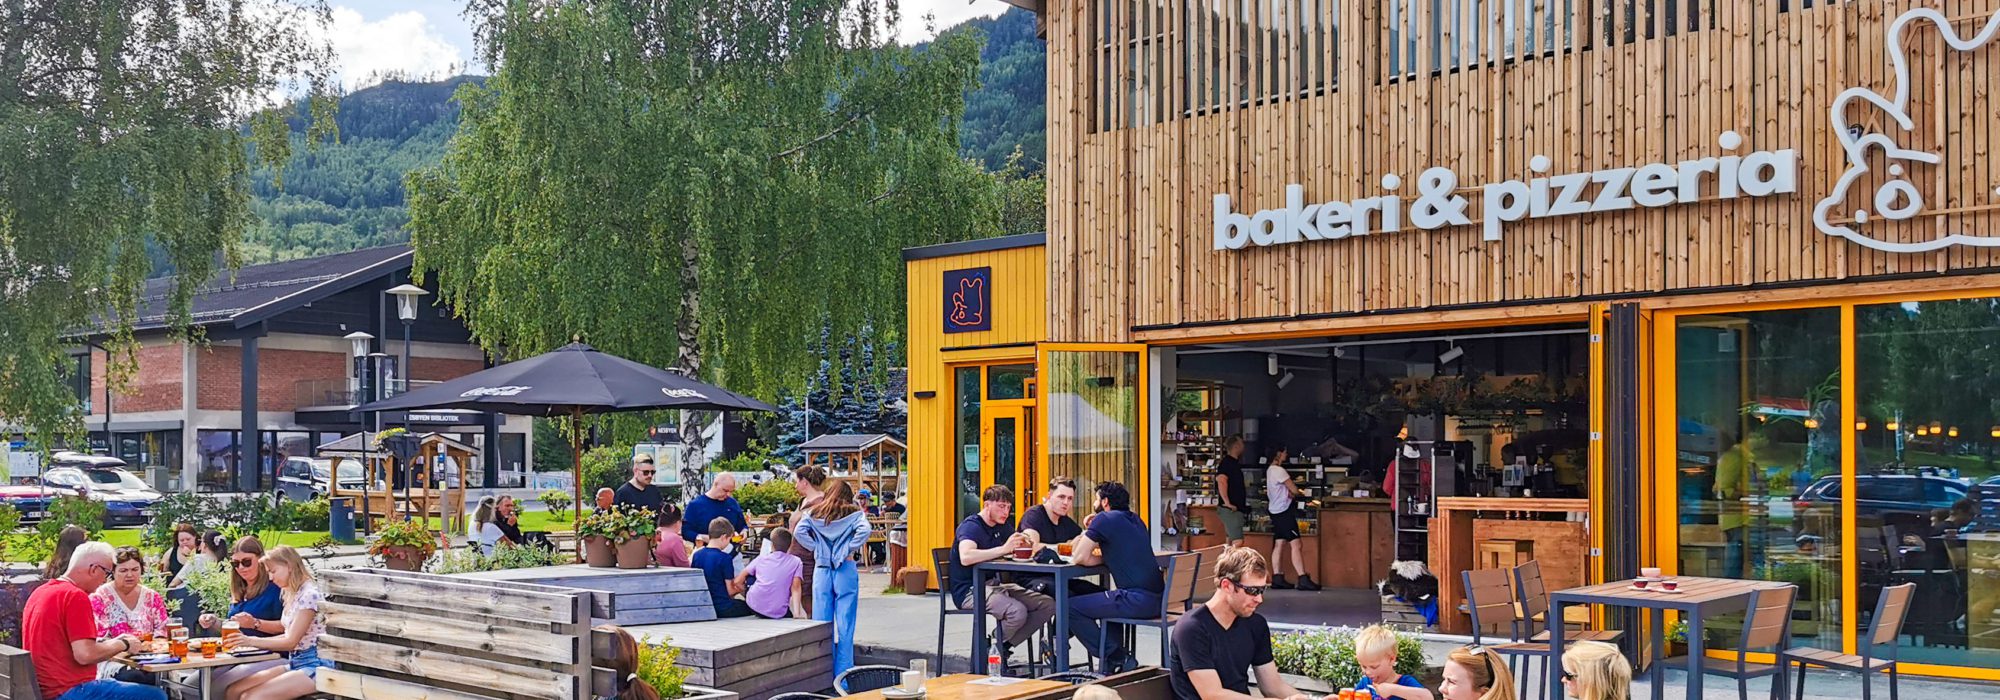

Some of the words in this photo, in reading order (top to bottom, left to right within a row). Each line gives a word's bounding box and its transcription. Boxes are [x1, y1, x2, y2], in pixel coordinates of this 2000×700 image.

[1213, 174, 1402, 250] bakeri
[1410, 166, 1474, 230] &
[1483, 130, 1799, 241] pizzeria
